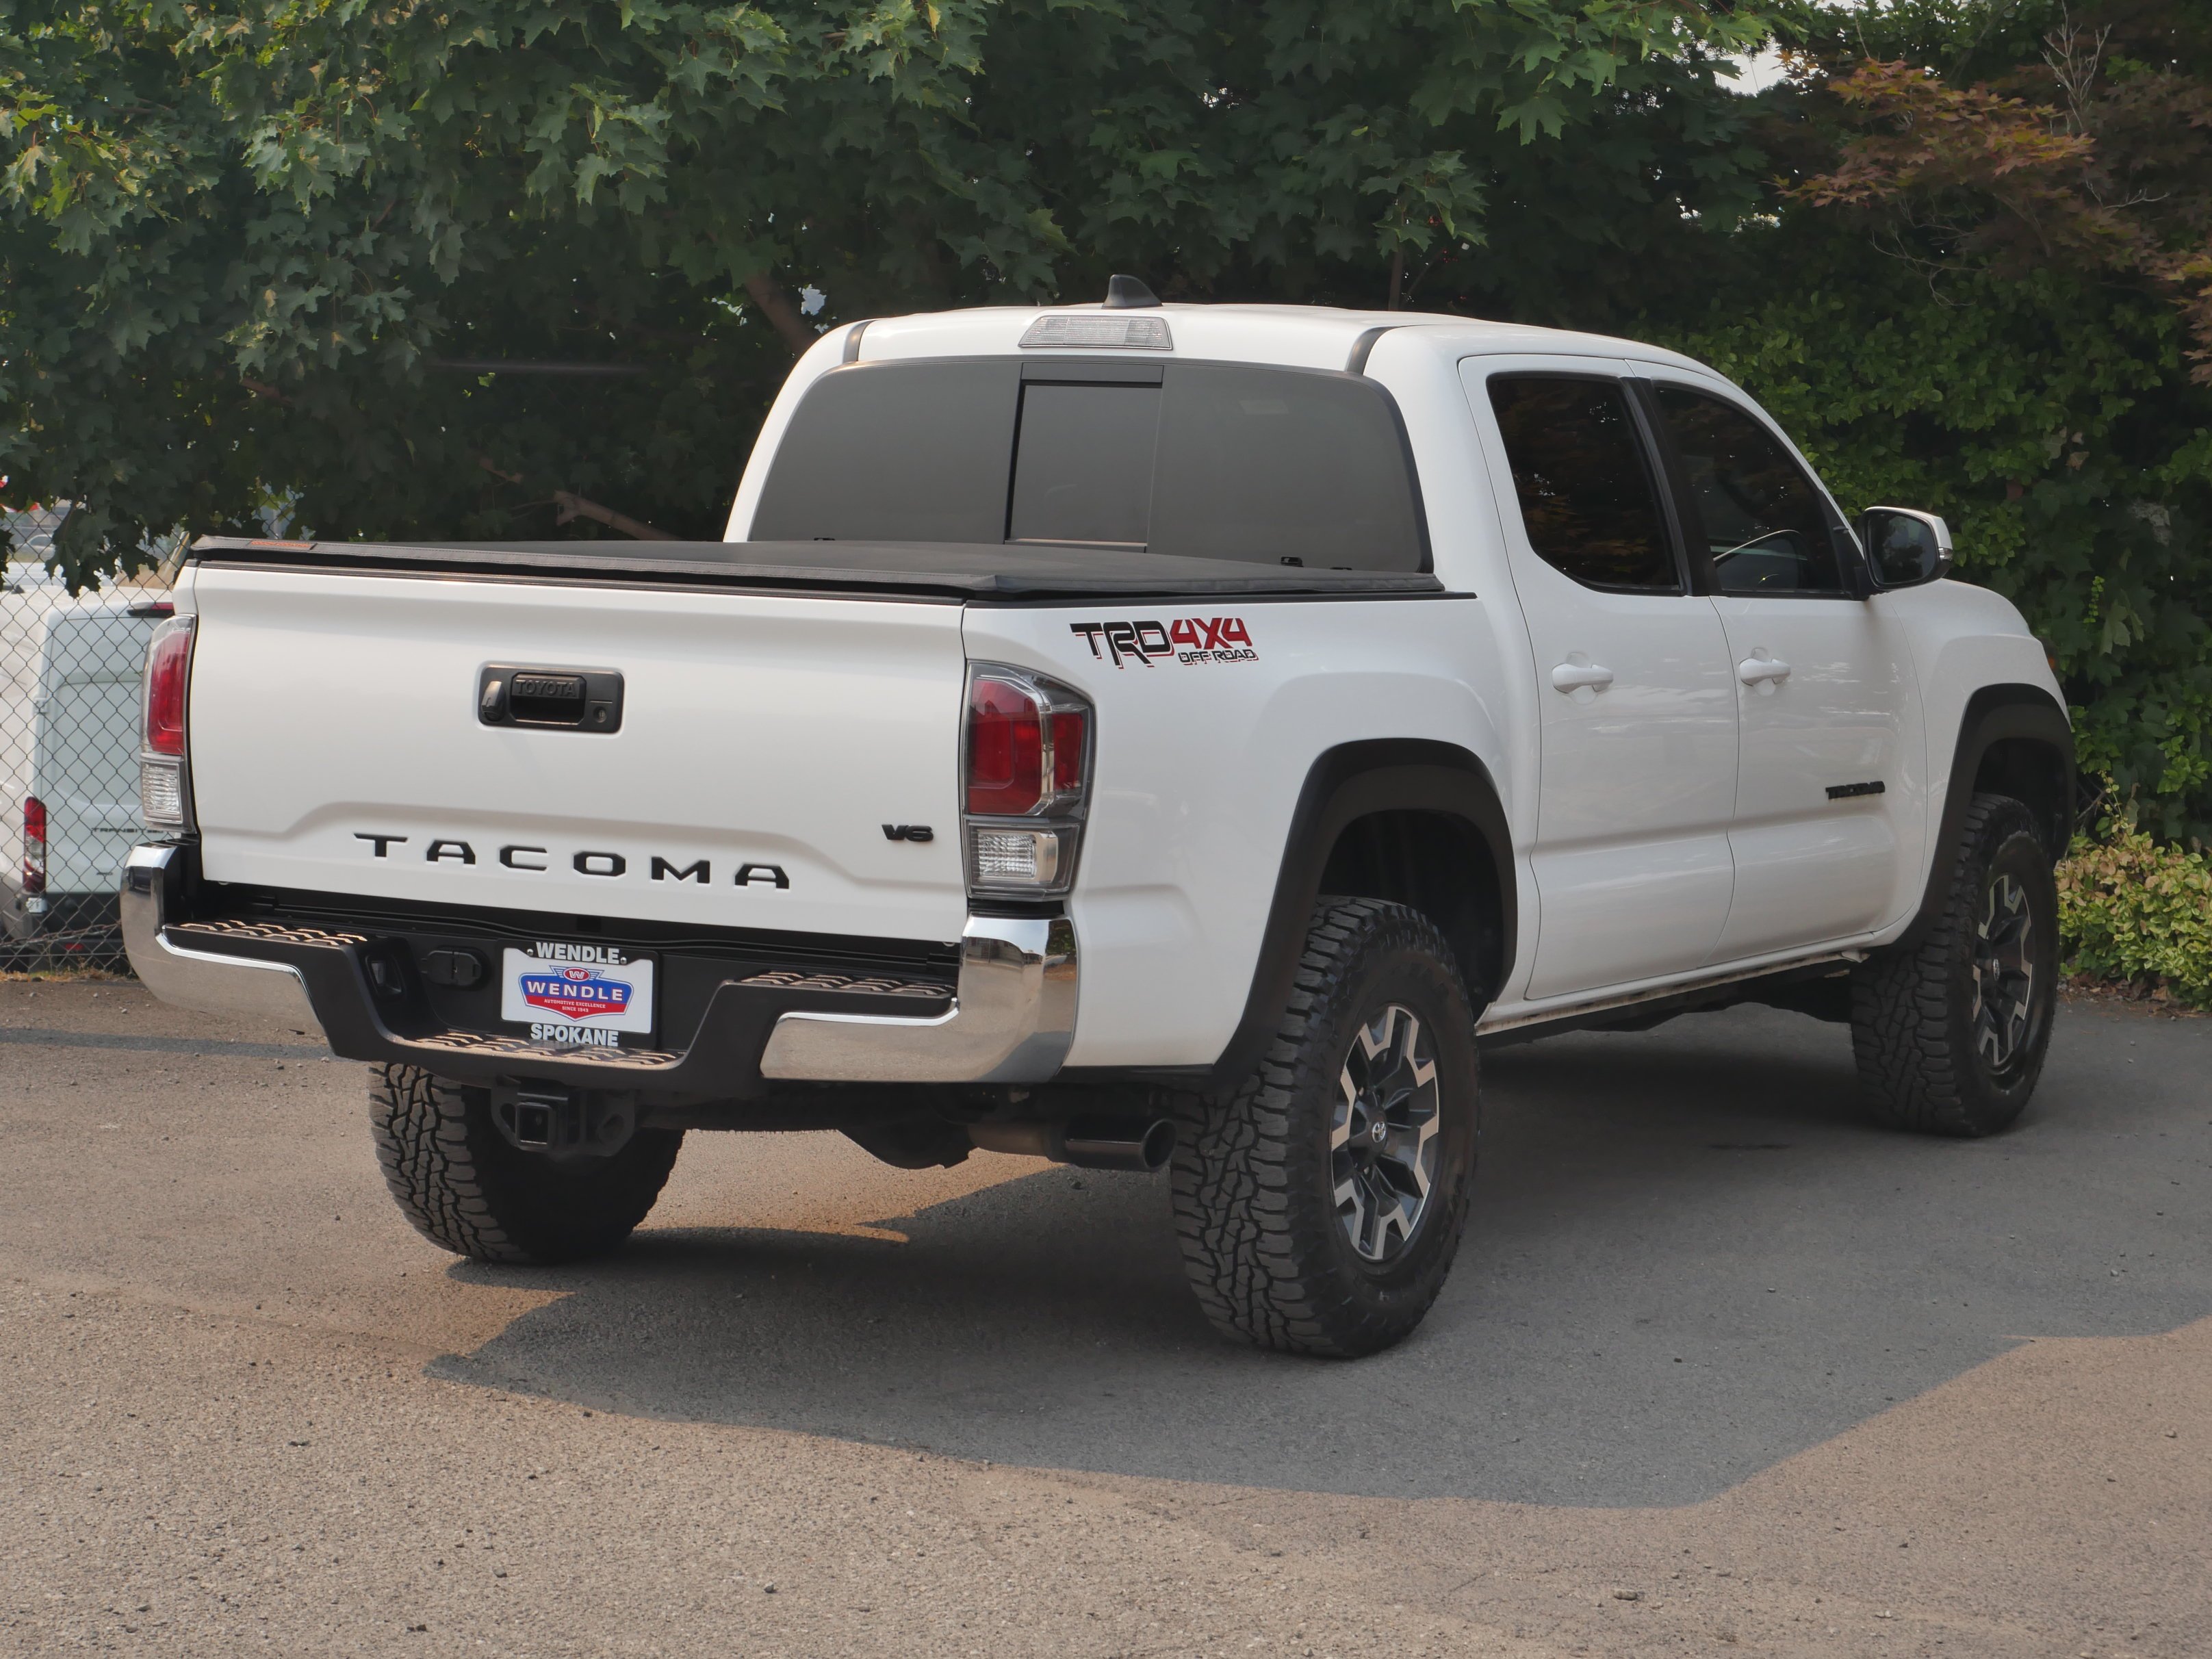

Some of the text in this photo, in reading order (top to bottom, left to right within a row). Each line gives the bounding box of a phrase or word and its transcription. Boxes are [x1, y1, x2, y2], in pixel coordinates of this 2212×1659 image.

[1070, 620, 1173, 668] TRD
[1178, 650, 1259, 665] OFF ROAD
[516, 680, 576, 697] TOYOTA
[882, 824, 934, 842] V6
[353, 832, 790, 889] TACOMA
[536, 942, 619, 964] WENDLE
[528, 981, 623, 1001] WENDLE
[530, 1024, 619, 1047] SPOKANE
